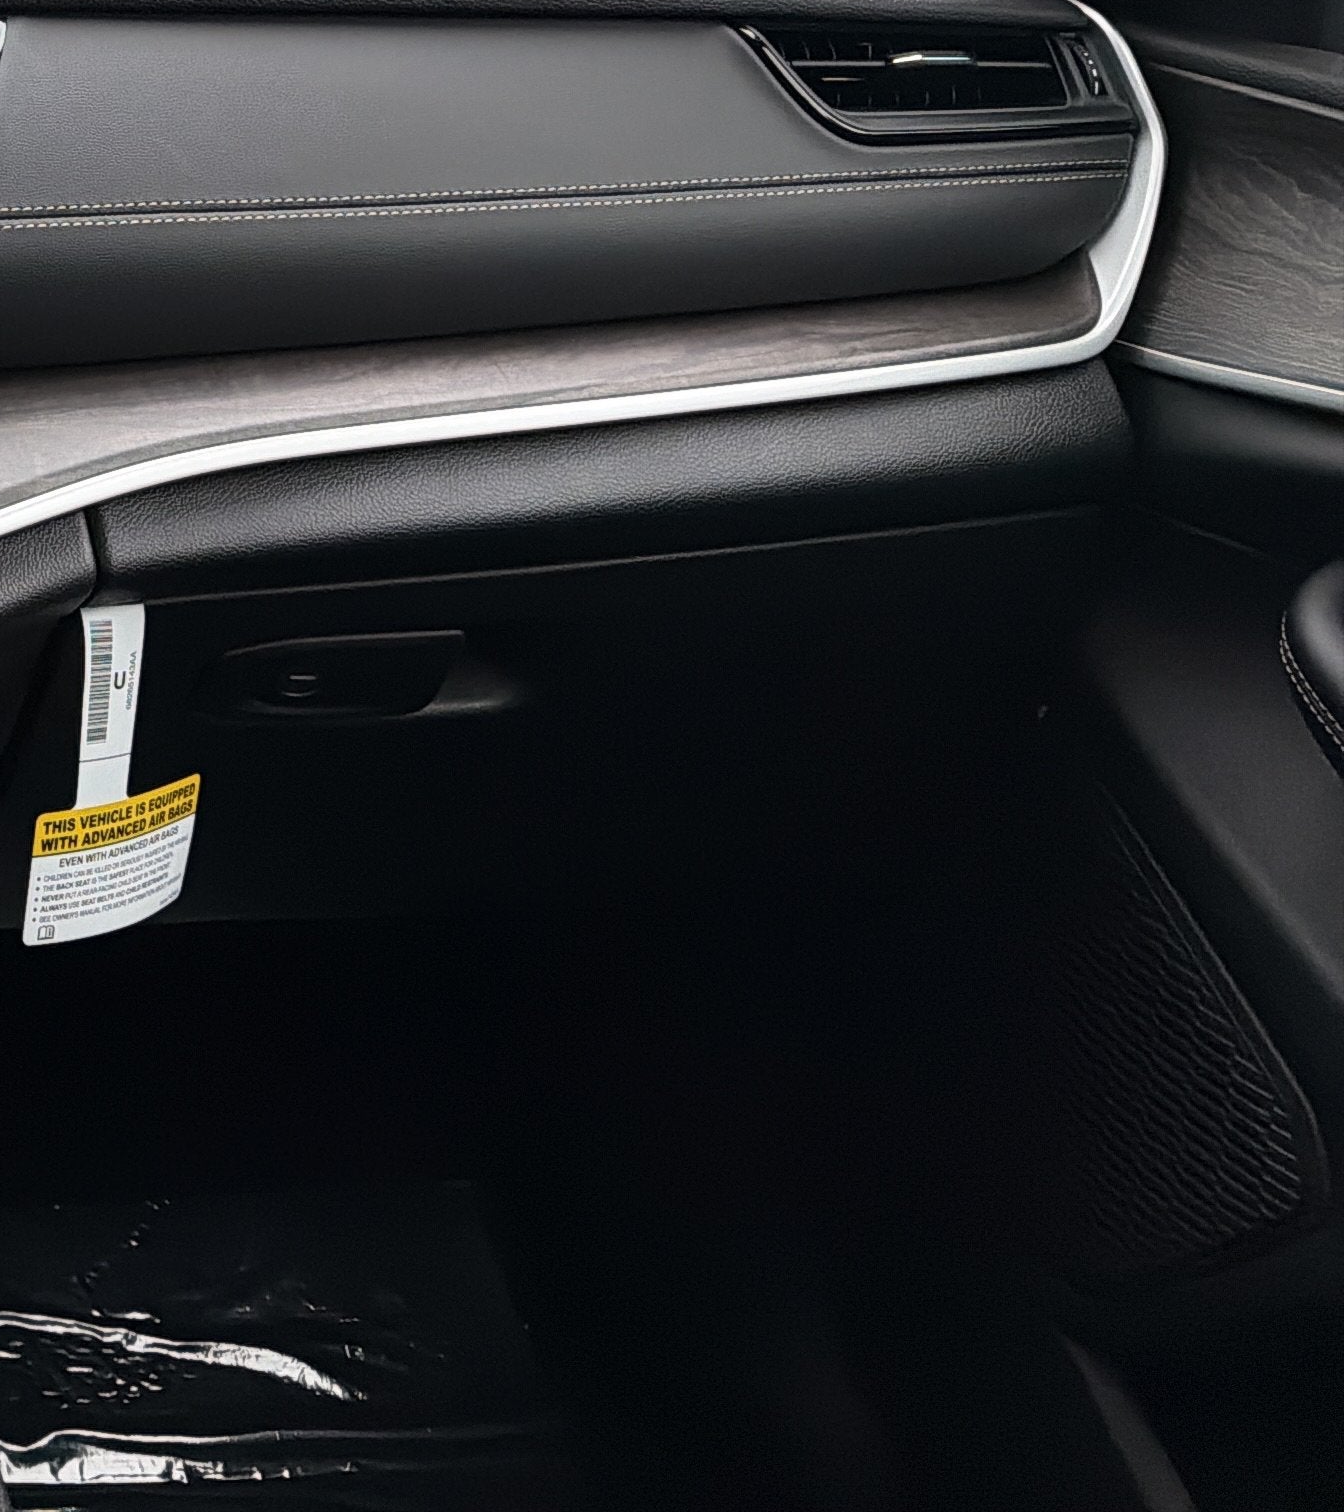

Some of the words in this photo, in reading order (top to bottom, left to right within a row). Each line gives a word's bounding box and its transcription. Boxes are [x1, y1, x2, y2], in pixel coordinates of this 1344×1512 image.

[114, 670, 126, 689] U
[43, 817, 76, 835] THIS
[80, 808, 133, 830] VEHICLE
[136, 804, 147, 817] IS
[148, 782, 196, 813] EQUIPPED
[41, 836, 78, 852] WITH
[81, 819, 146, 846] ADVANCED
[148, 811, 166, 826] AIR
[168, 798, 193, 821] BAGS
[59, 855, 84, 868] EVEN
[85, 850, 108, 863] WITH
[108, 838, 148, 859] ADVANCED
[56, 881, 74, 891] BACK
[75, 878, 90, 887] SEAT
[41, 893, 64, 902] NEVER
[40, 903, 67, 913] ALWAYS
